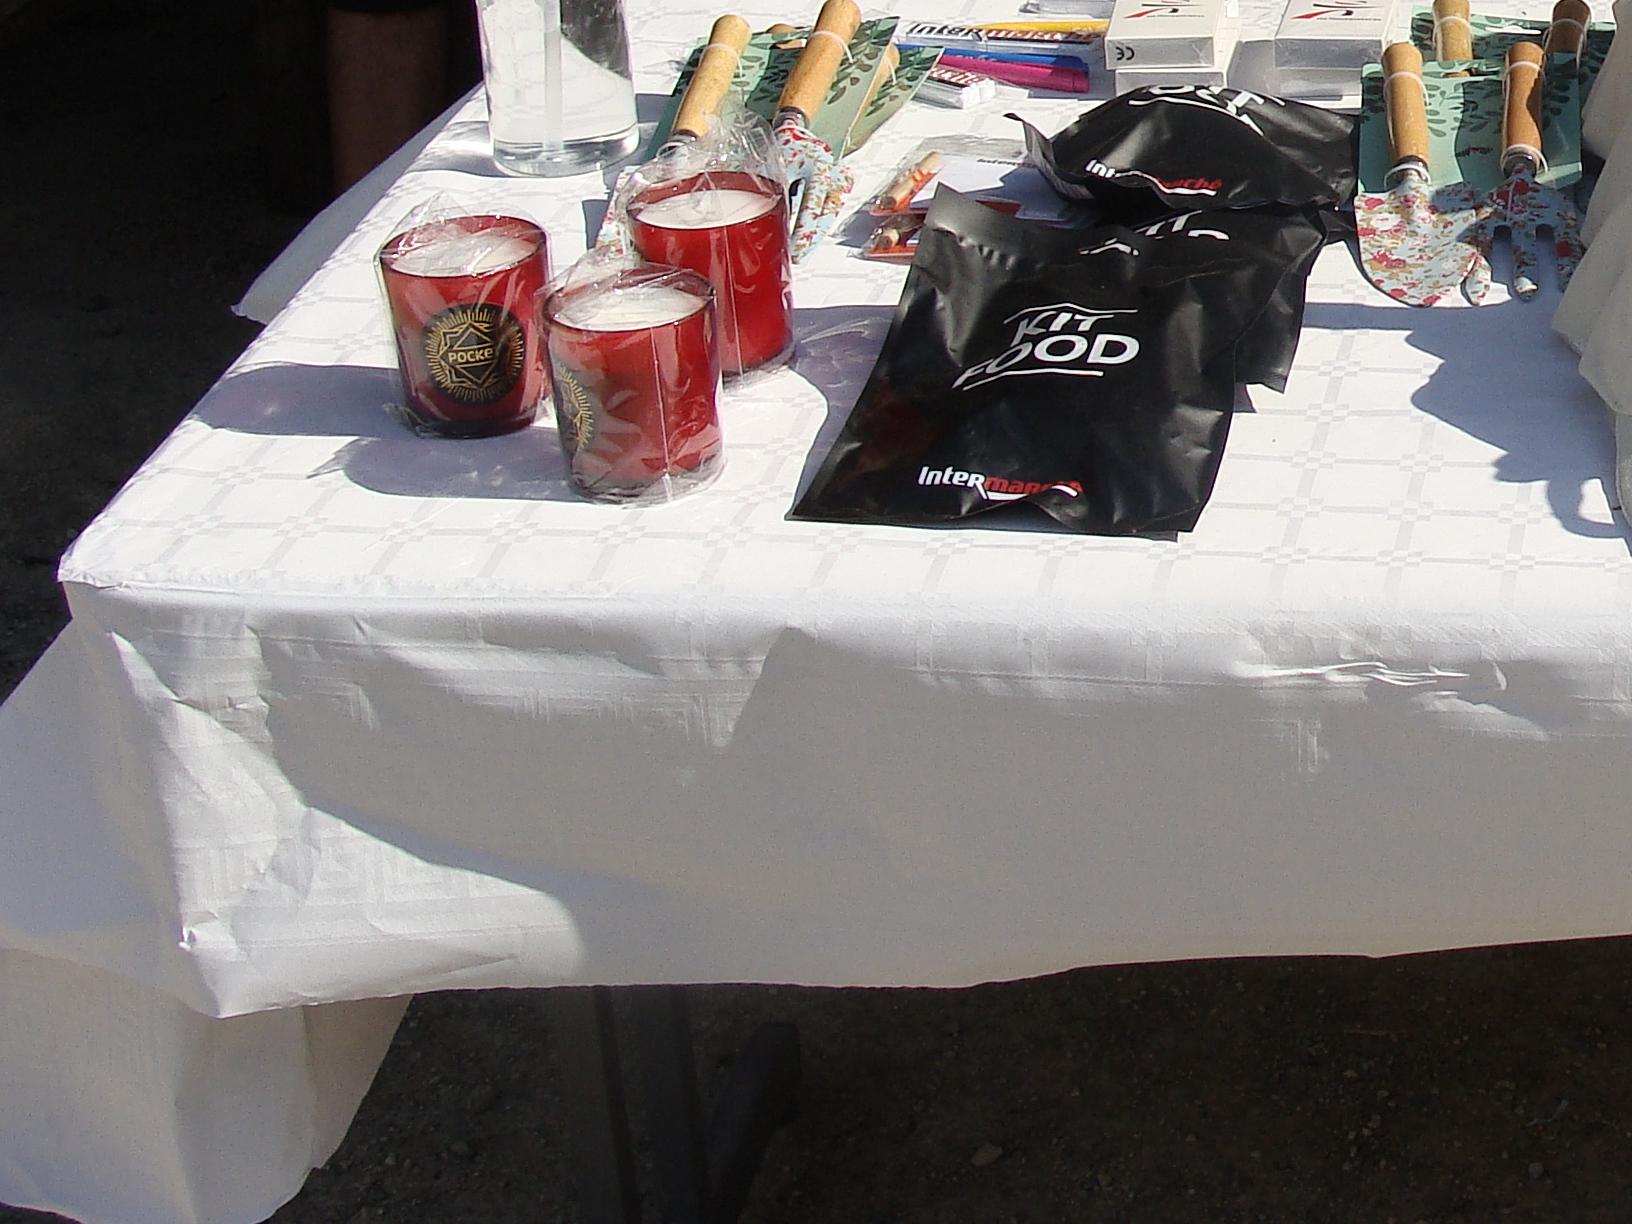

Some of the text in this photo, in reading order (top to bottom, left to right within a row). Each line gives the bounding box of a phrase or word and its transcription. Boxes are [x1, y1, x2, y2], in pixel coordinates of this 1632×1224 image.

[1010, 310, 1115, 347] KIT
[952, 334, 1140, 389] FOOD
[917, 465, 1084, 501] Intermar
